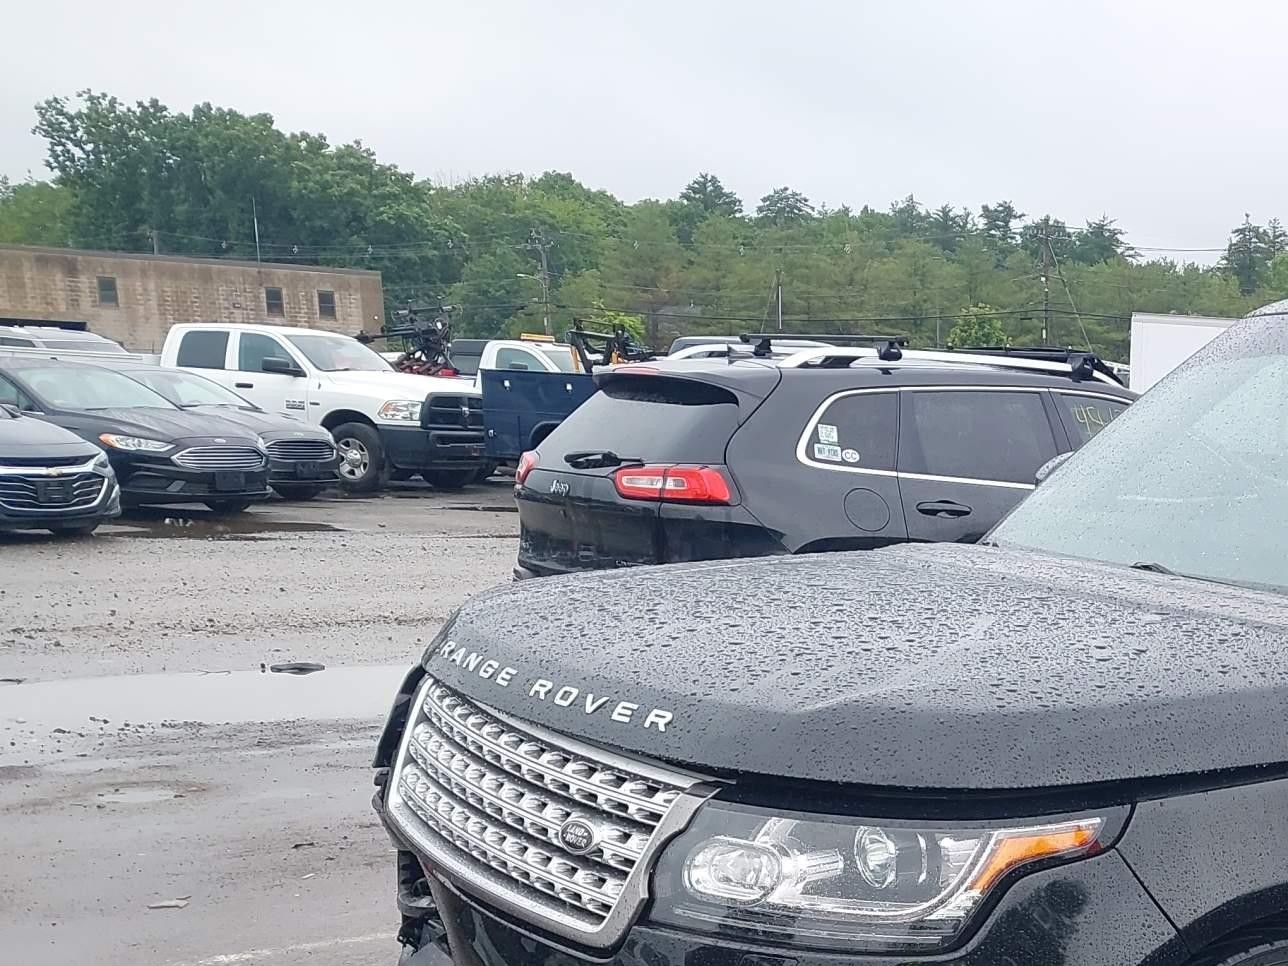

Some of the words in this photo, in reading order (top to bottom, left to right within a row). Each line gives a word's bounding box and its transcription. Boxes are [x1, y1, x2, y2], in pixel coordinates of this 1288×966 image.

[440, 640, 518, 687] RANGE
[528, 679, 674, 732] ROVER
[567, 824, 585, 836] LAND
[565, 834, 588, 848] ROVER
